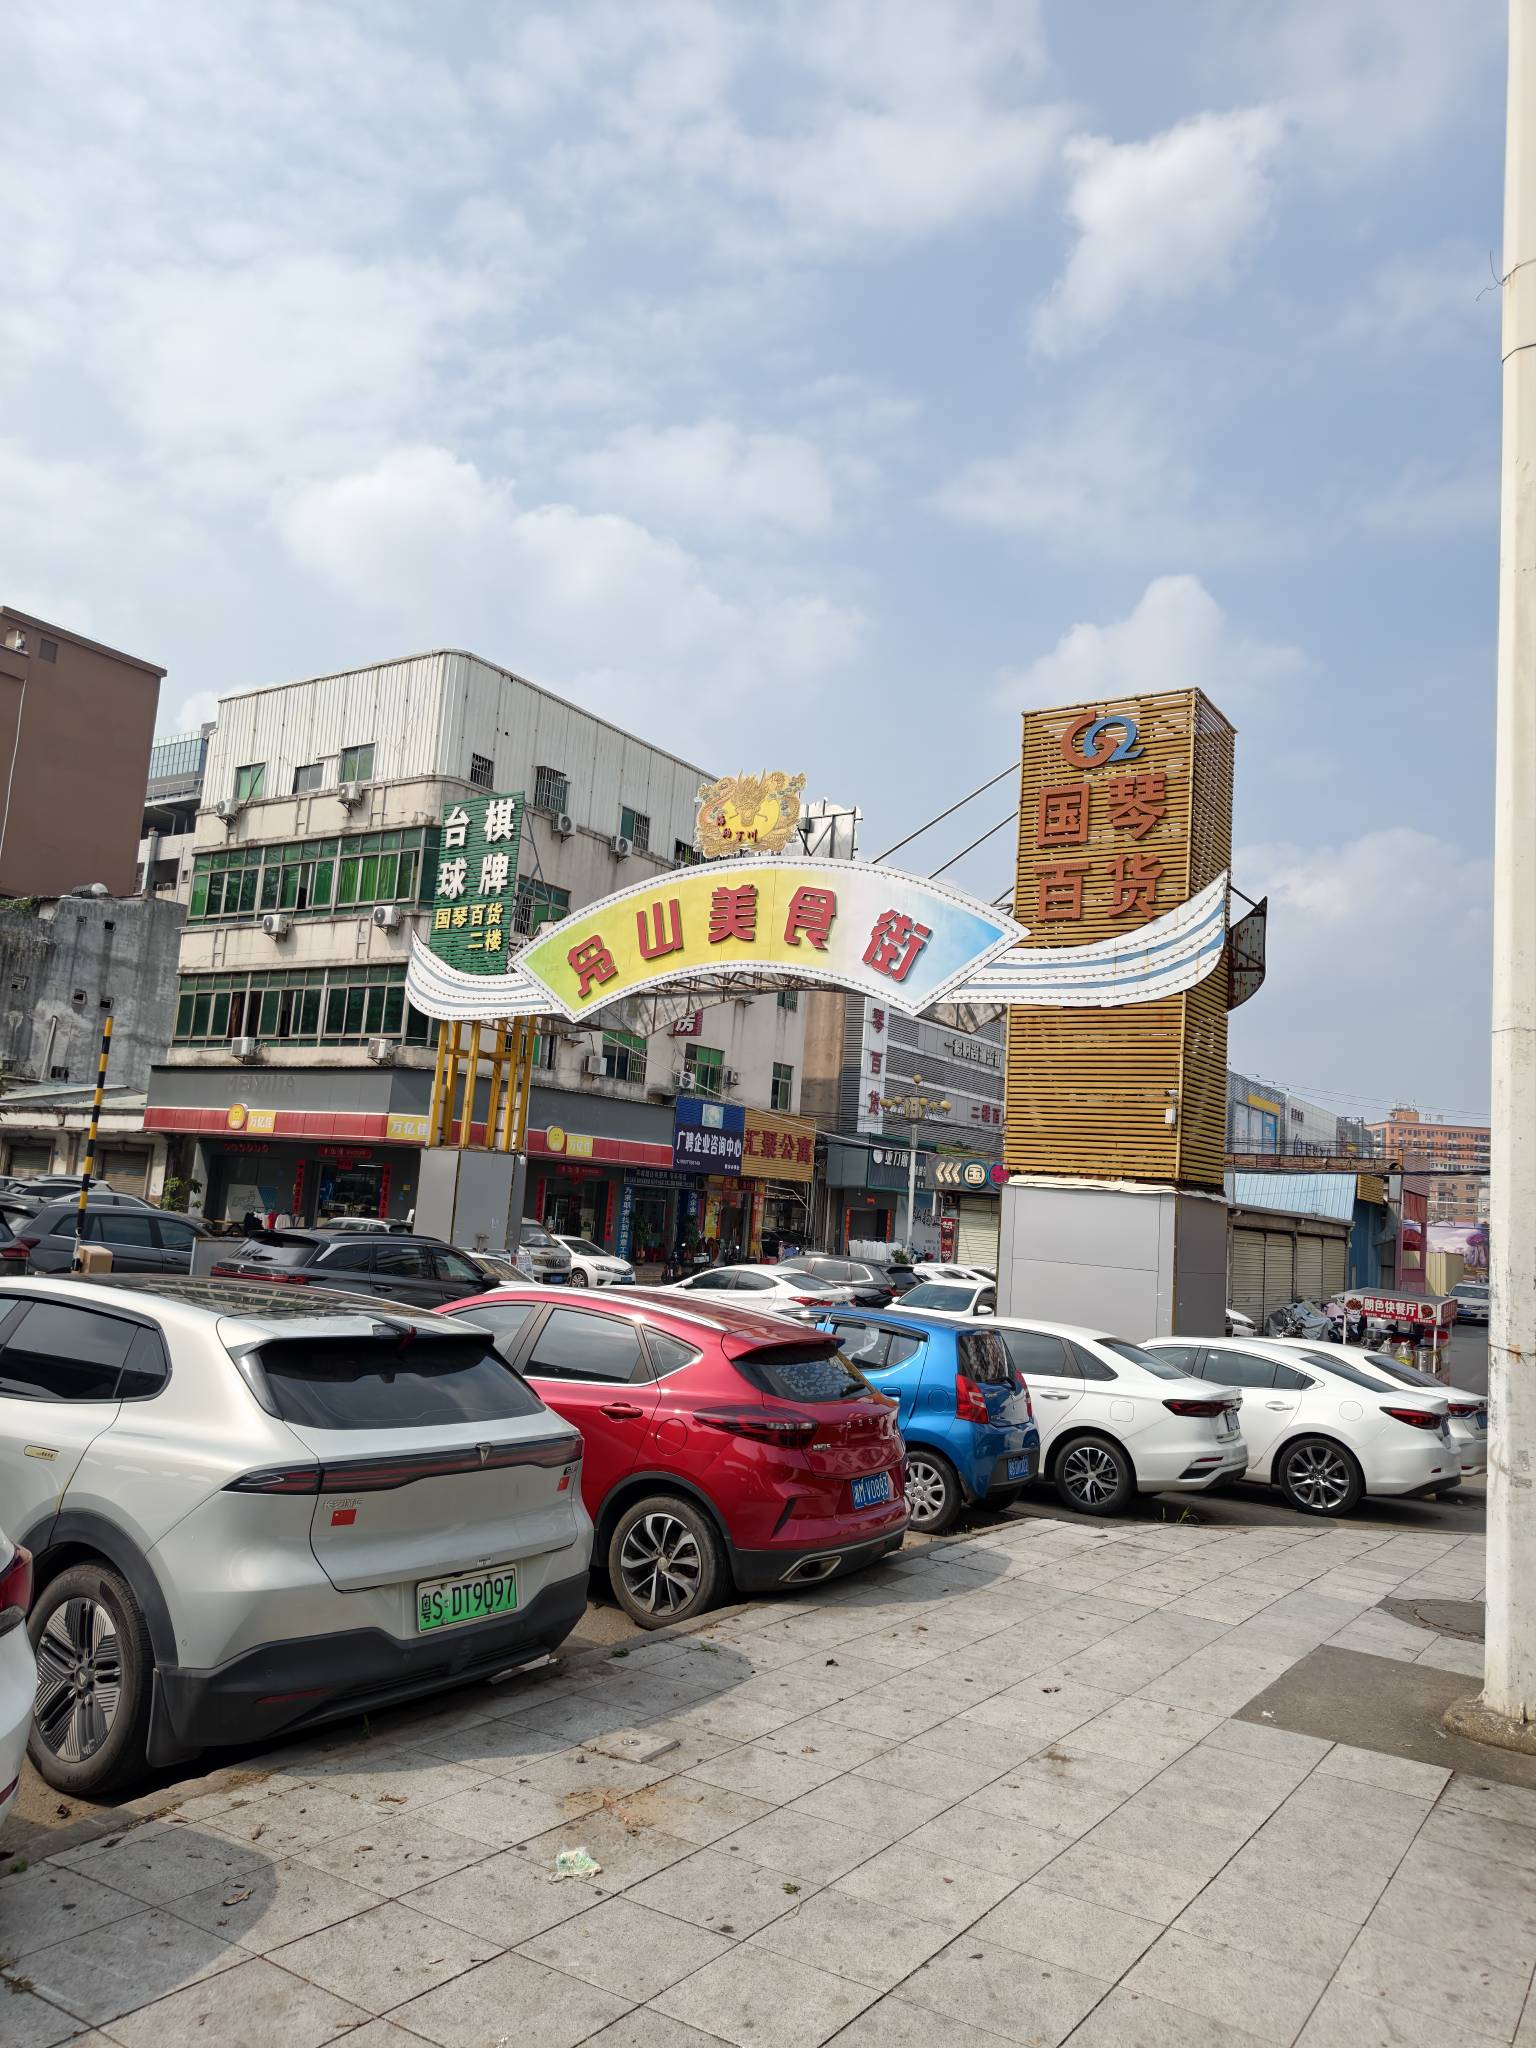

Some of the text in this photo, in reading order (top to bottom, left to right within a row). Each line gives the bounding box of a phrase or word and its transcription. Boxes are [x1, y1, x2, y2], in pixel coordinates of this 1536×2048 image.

[1037, 772, 1168, 848] 国琴
[437, 806, 471, 900] 台球
[478, 798, 516, 896] 棋牌
[1033, 853, 1165, 921] 百货
[434, 902, 504, 930] 国琴百货
[468, 929, 503, 952] 二楼
[567, 883, 932, 998] 凫山美食街
[677, 1130, 742, 1158] 广聘企业咨询中心
[744, 1128, 812, 1162] 汇聚公寓
[1364, 1298, 1417, 1317] 朗色快餐厅
